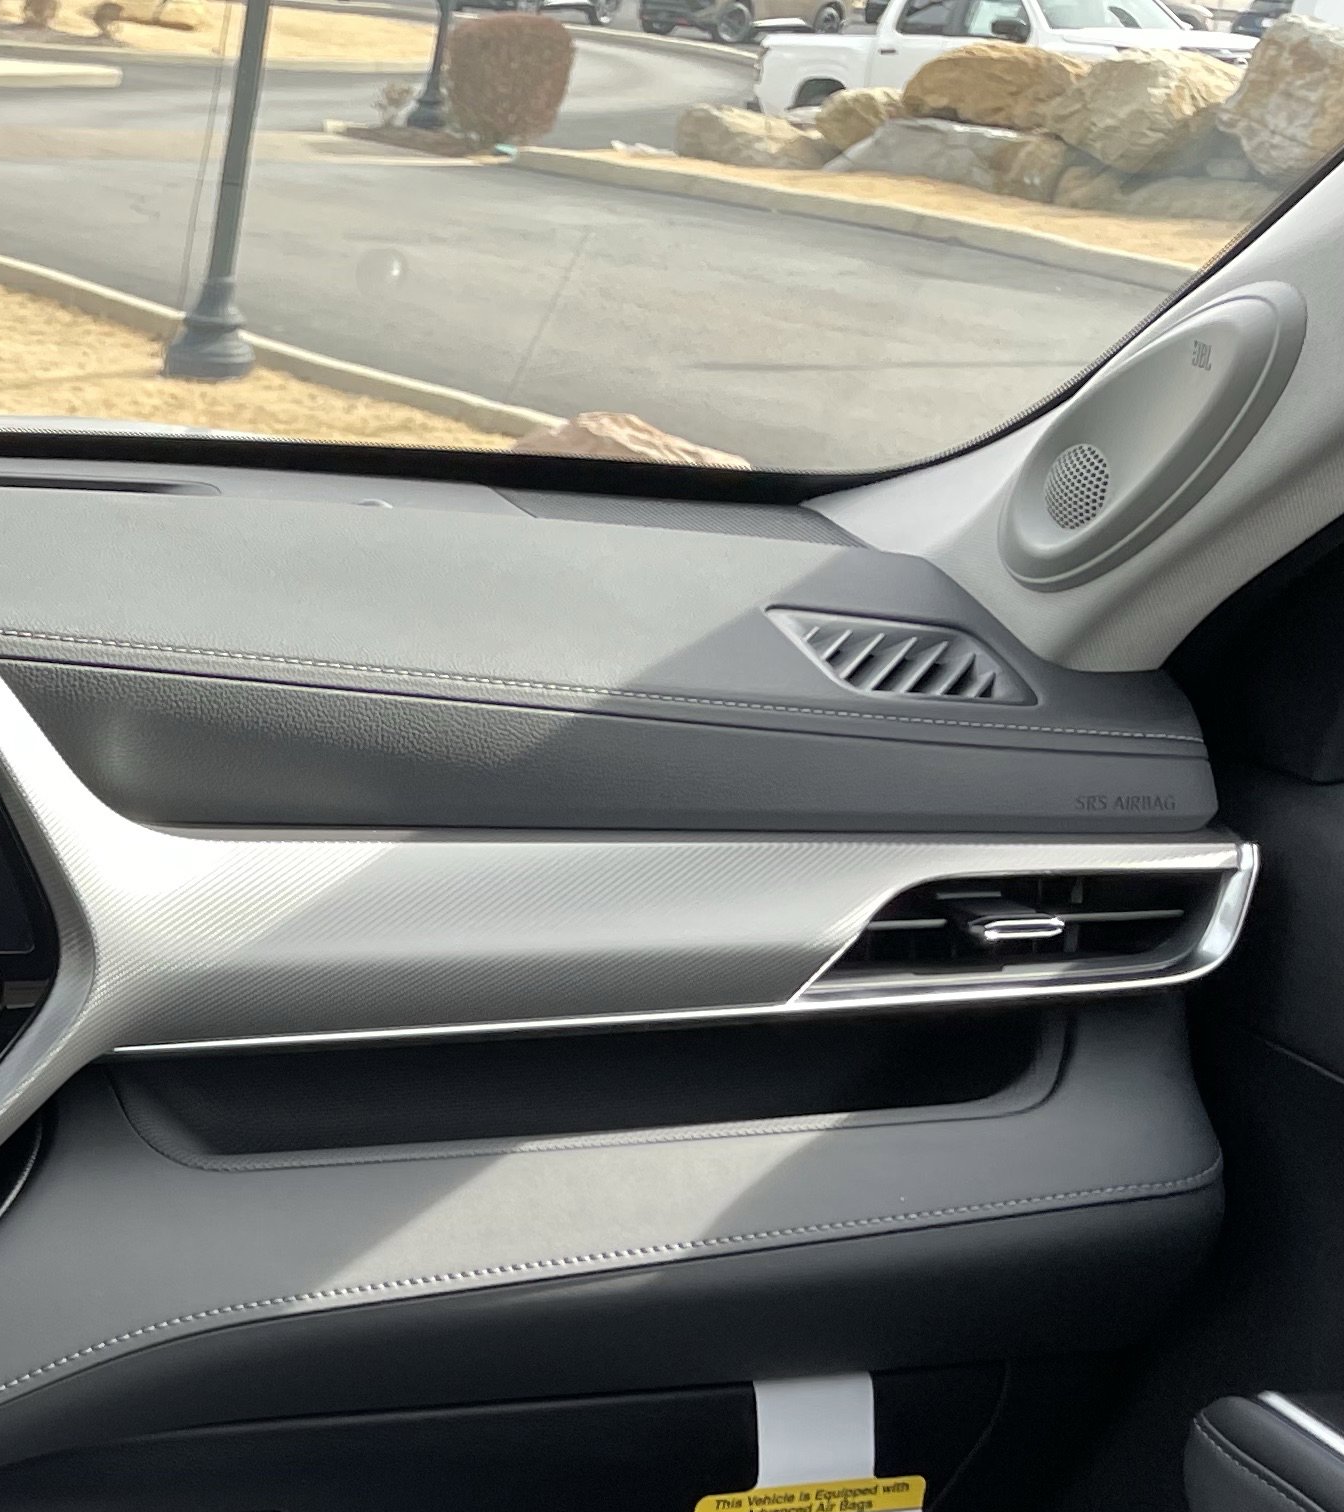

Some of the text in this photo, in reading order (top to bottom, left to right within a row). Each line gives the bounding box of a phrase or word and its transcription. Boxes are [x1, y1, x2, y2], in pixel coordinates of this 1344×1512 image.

[1191, 339, 1211, 371] JBL
[1075, 795, 1107, 811] SRS
[715, 1482, 910, 1510] This Vehicle is Equipped with
[816, 1502, 837, 1512] Air
[839, 1498, 874, 1512] Bags
